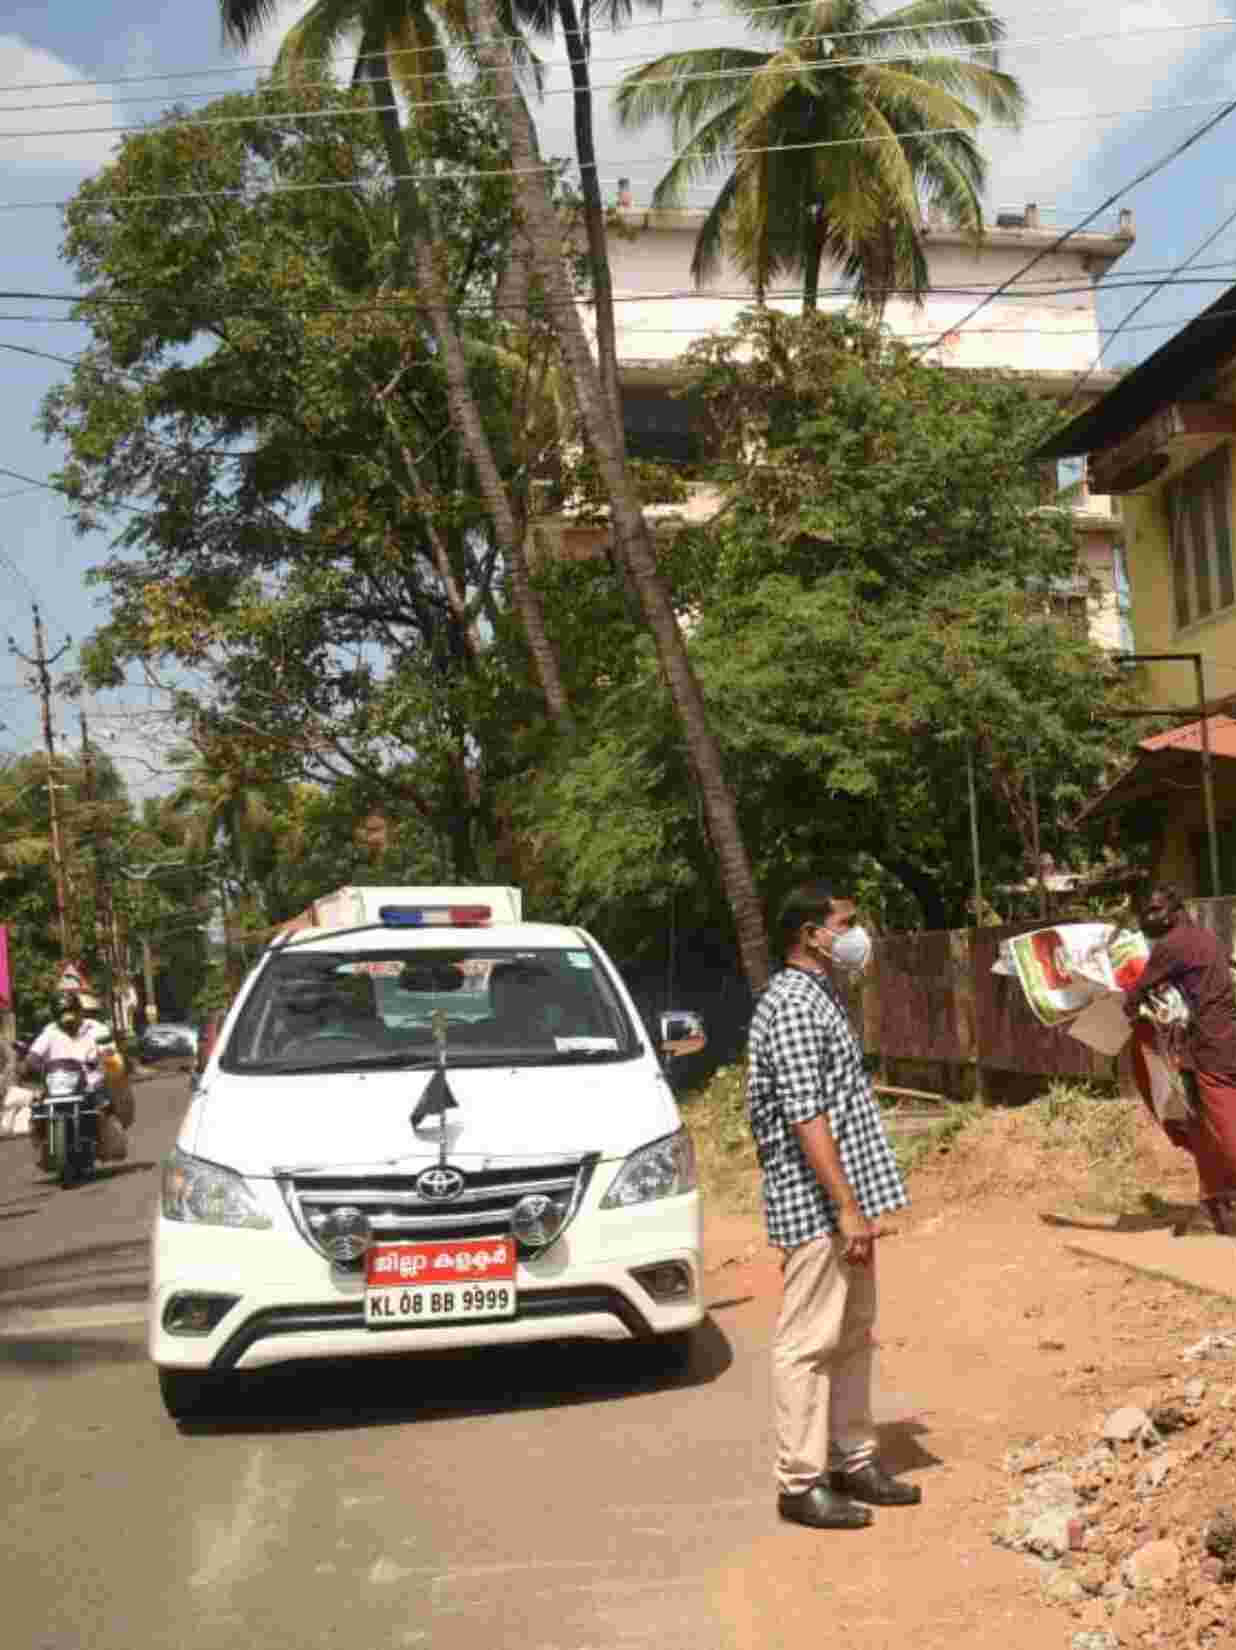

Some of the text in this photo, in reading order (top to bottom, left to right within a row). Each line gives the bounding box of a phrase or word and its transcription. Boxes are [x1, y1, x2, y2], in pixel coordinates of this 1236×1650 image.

[370, 1287, 510, 1317] KL 08 BB 9999
